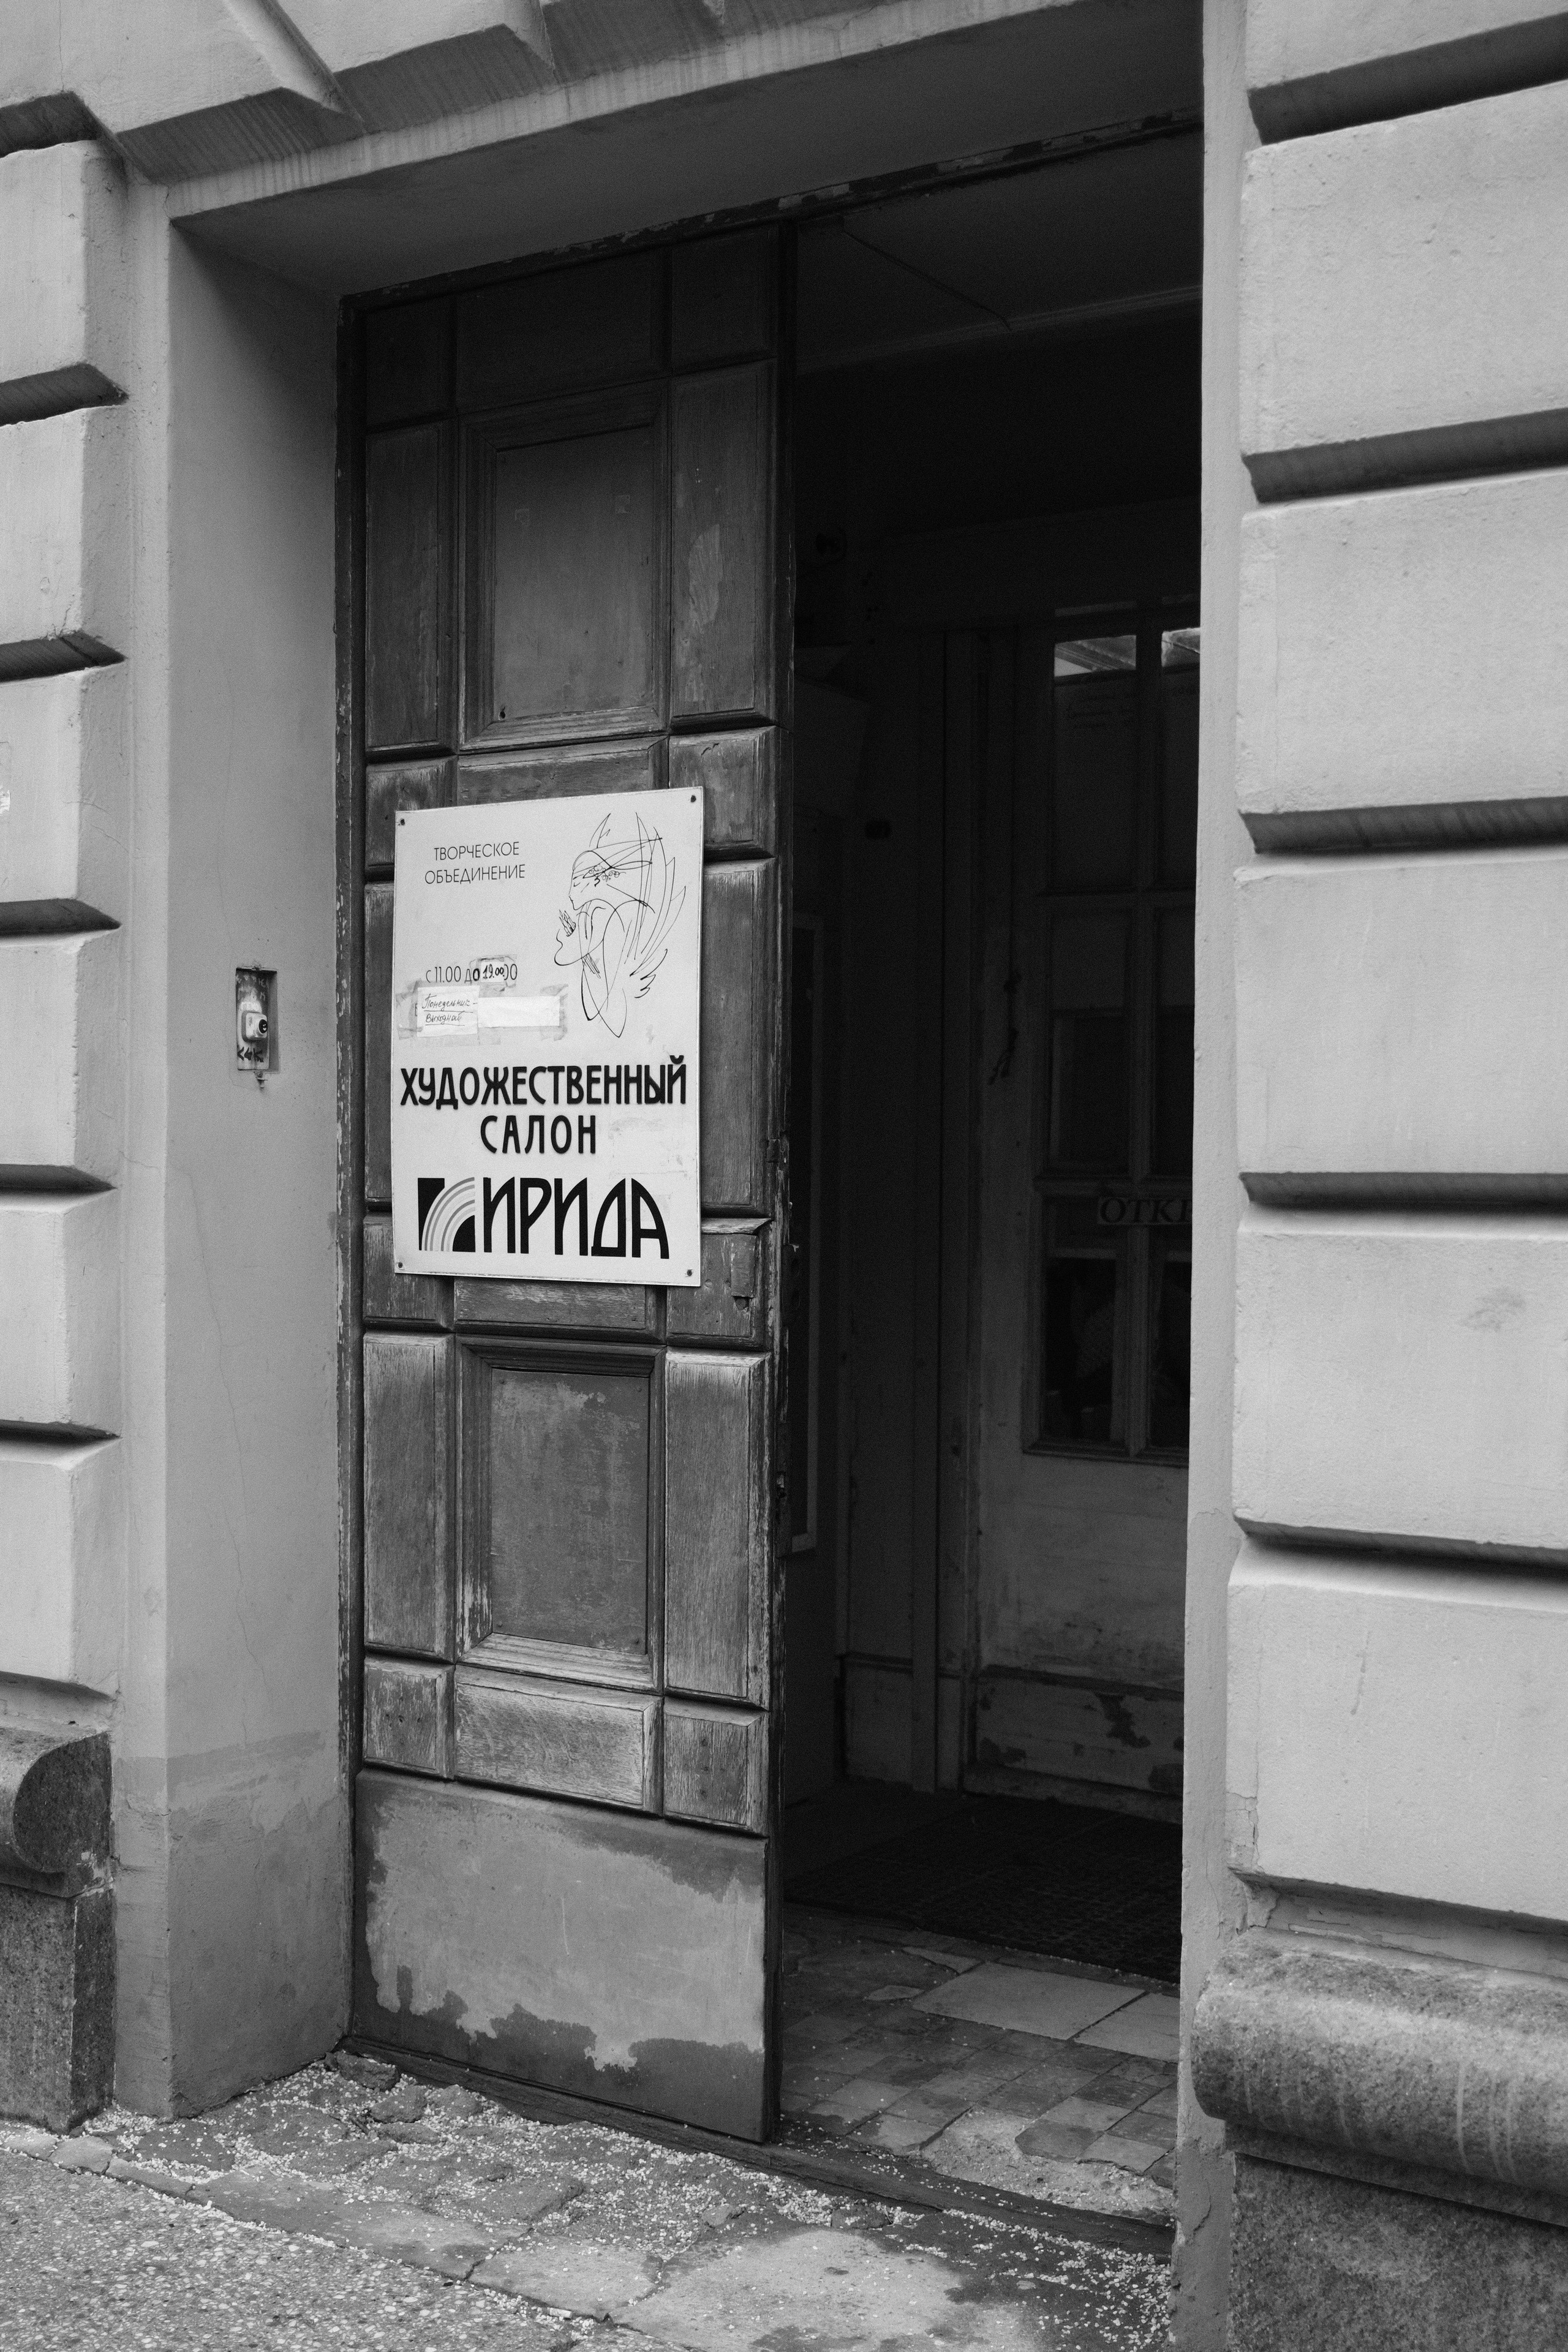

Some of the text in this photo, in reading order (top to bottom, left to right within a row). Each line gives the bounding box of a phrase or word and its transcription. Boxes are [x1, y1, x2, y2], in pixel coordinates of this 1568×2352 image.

[434, 841, 520, 861] ТВОРЧЕСКОЕ
[424, 864, 526, 884] ОБЪЕДИНЕНИЕ
[434, 965, 462, 983] 11.00
[400, 1055, 687, 1110] ХУДОЖЕСТВЕННЫЙ
[480, 1115, 596, 1154] САЛОН
[483, 1176, 670, 1259] ИРИДА
